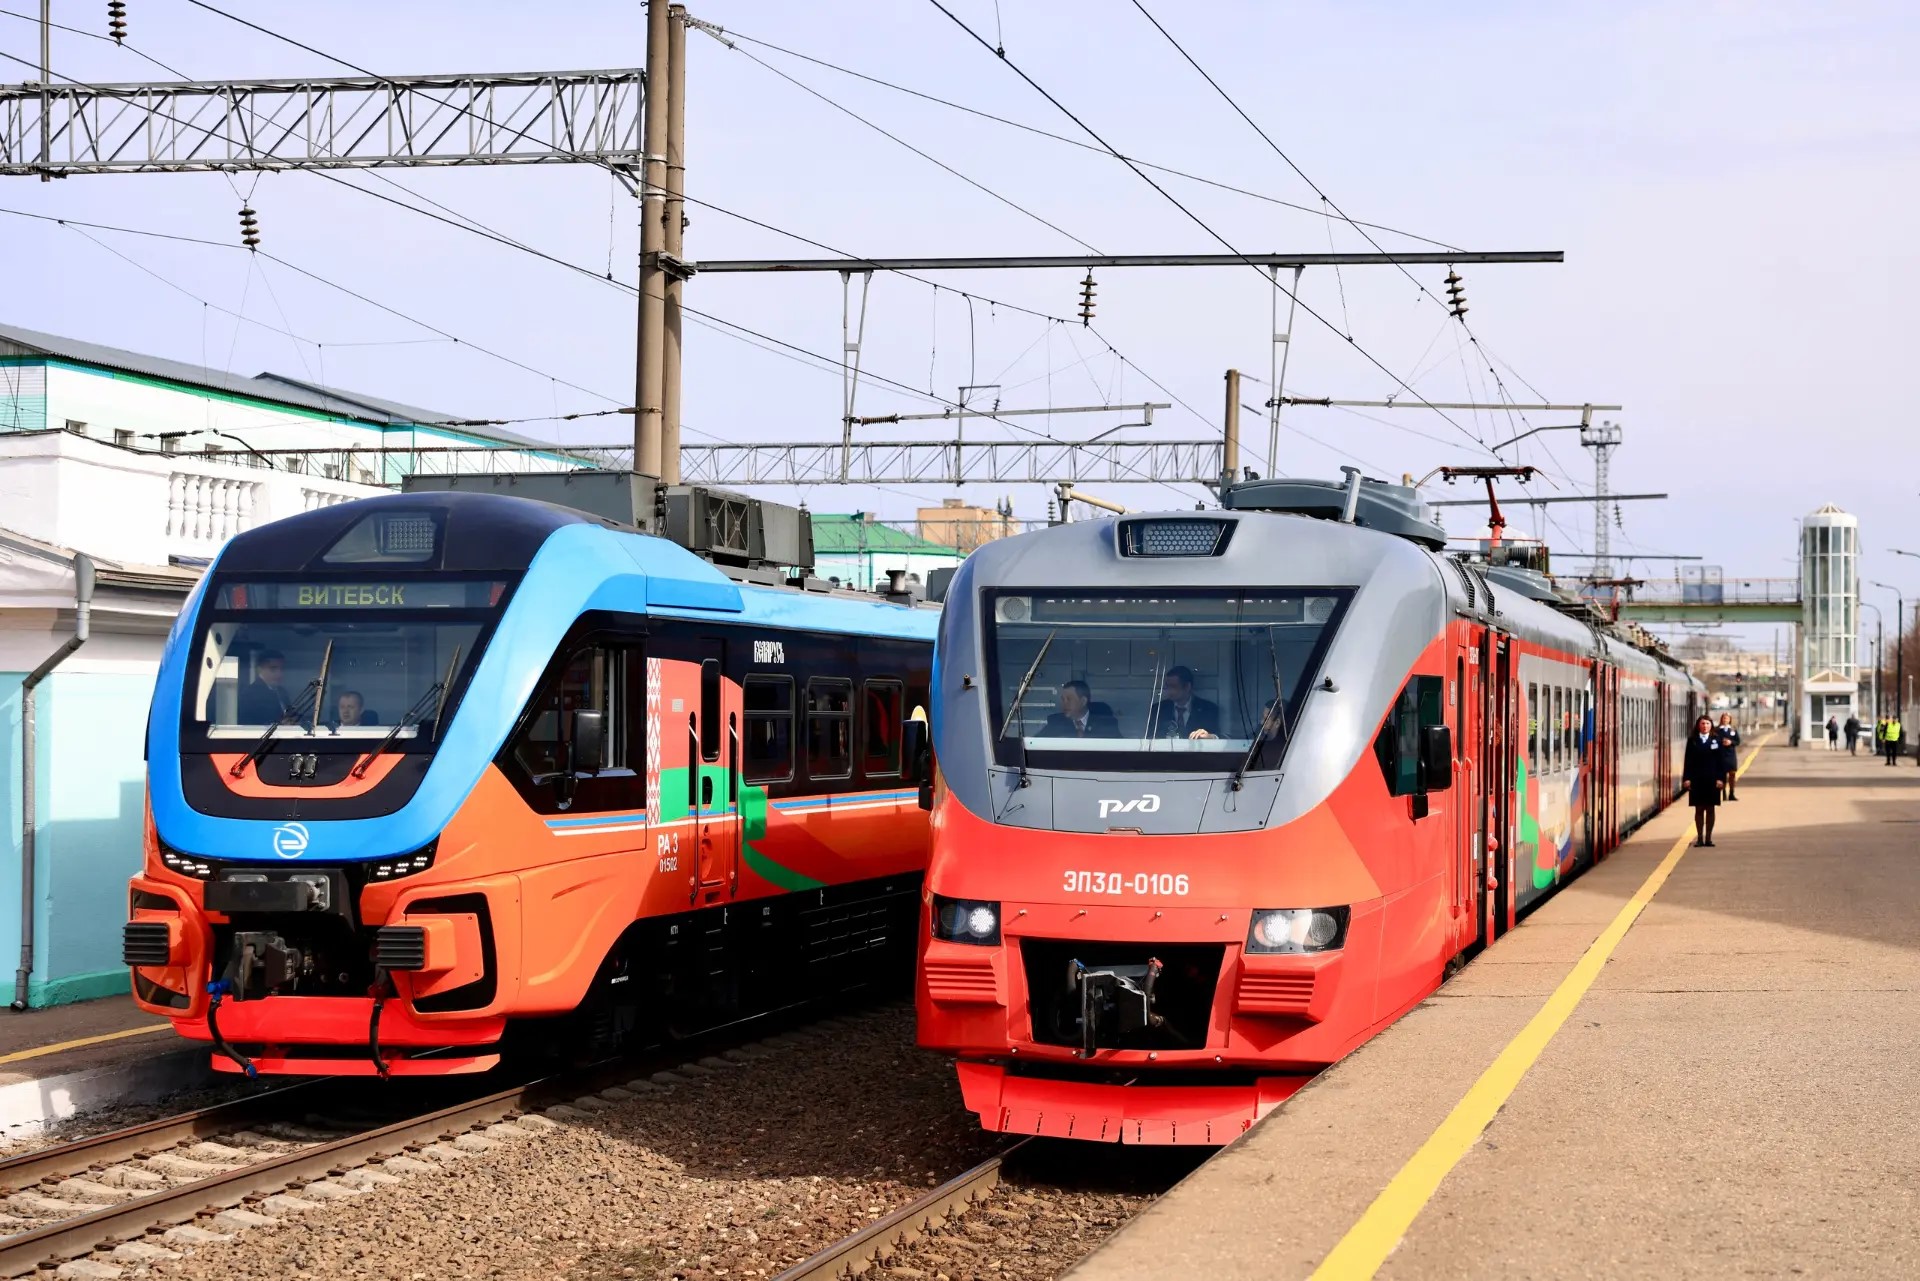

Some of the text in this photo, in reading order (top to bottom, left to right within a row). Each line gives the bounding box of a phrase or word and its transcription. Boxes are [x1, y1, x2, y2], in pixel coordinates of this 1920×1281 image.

[299, 586, 405, 605] ВИТЕБСК
[657, 831, 679, 856] РА 3
[1062, 870, 1190, 896] ЭП3Д-0106
